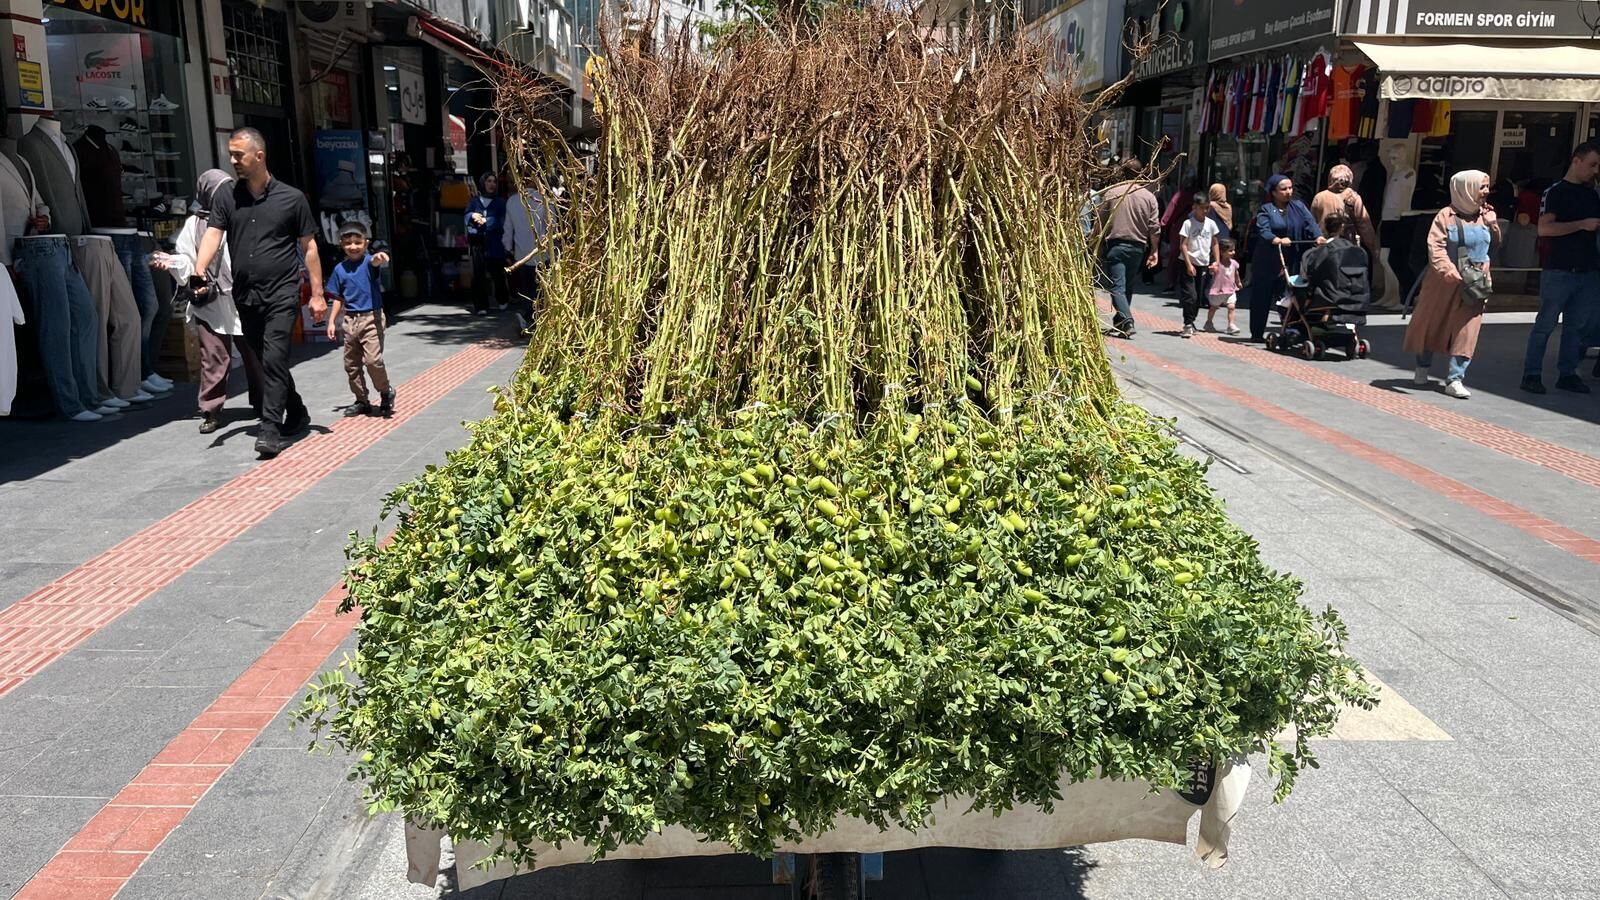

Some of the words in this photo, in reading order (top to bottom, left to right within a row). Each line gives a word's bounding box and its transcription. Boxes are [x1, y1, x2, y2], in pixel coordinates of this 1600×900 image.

[1417, 12, 1473, 26] FORMEN
[1476, 13, 1513, 27] SPOR
[1516, 11, 1555, 28] GİYİM
[1187, 40, 1194, 65] 3
[85, 71, 121, 80] LACOSTE
[1417, 77, 1485, 97] adipro
[316, 138, 359, 152] beyazsu
